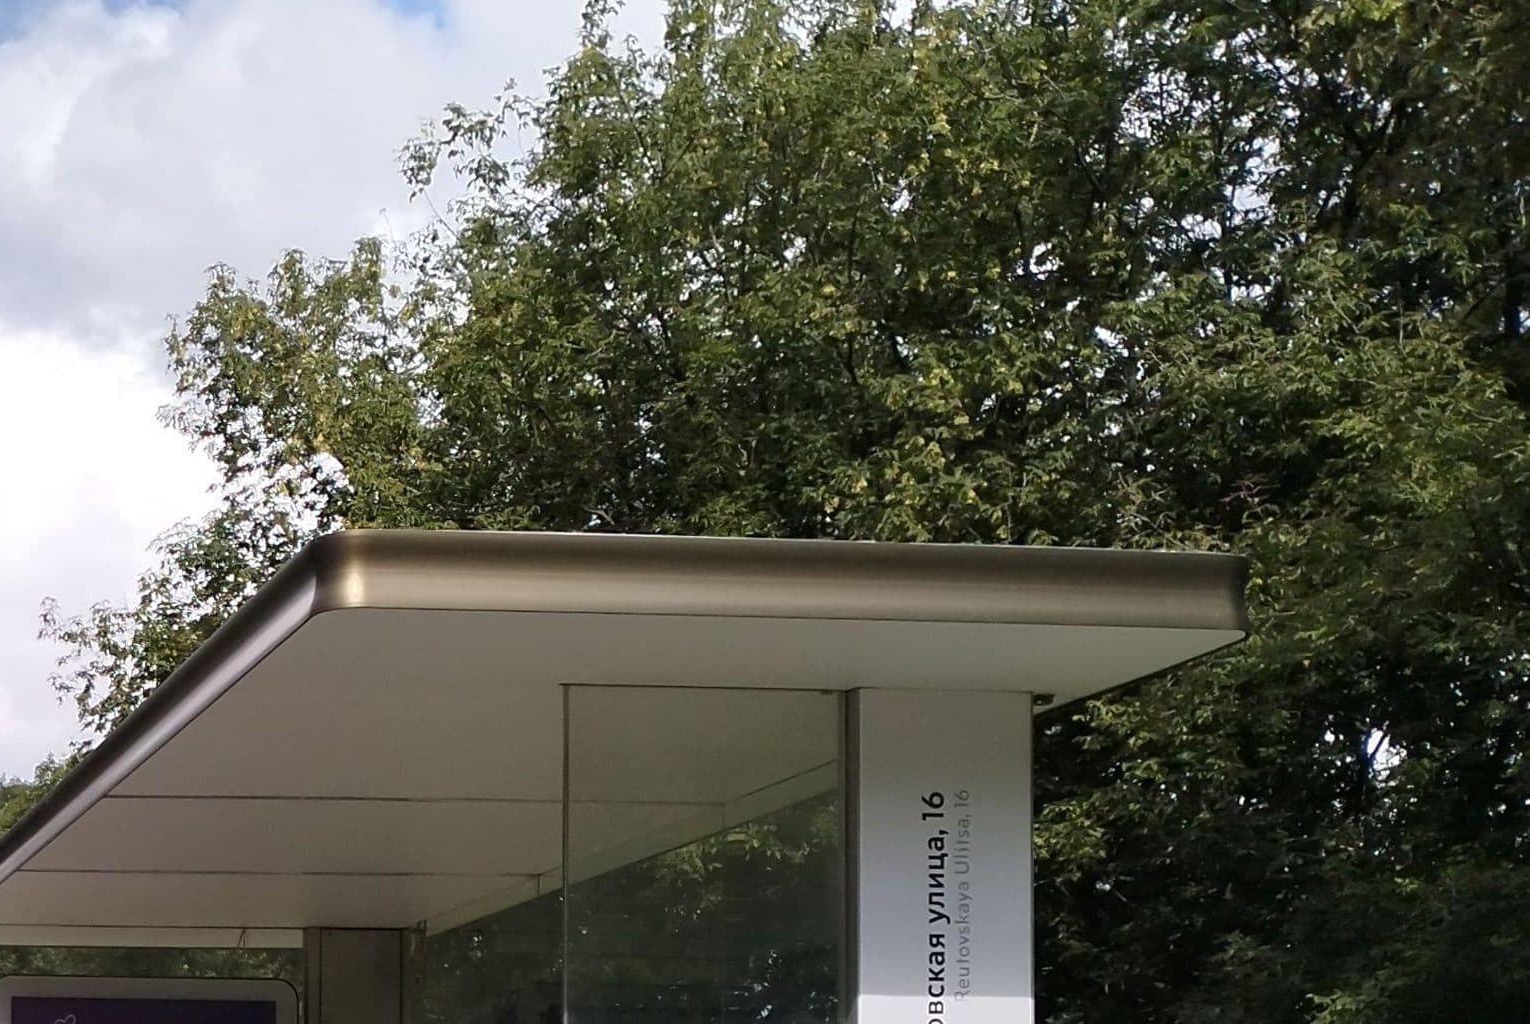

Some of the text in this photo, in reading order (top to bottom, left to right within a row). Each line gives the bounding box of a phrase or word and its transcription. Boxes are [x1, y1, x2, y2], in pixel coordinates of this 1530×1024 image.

[921, 791, 945, 821] 16
[954, 789, 970, 808] 16
[927, 828, 951, 925] улица,
[954, 881, 974, 1002] Reutovskaya
